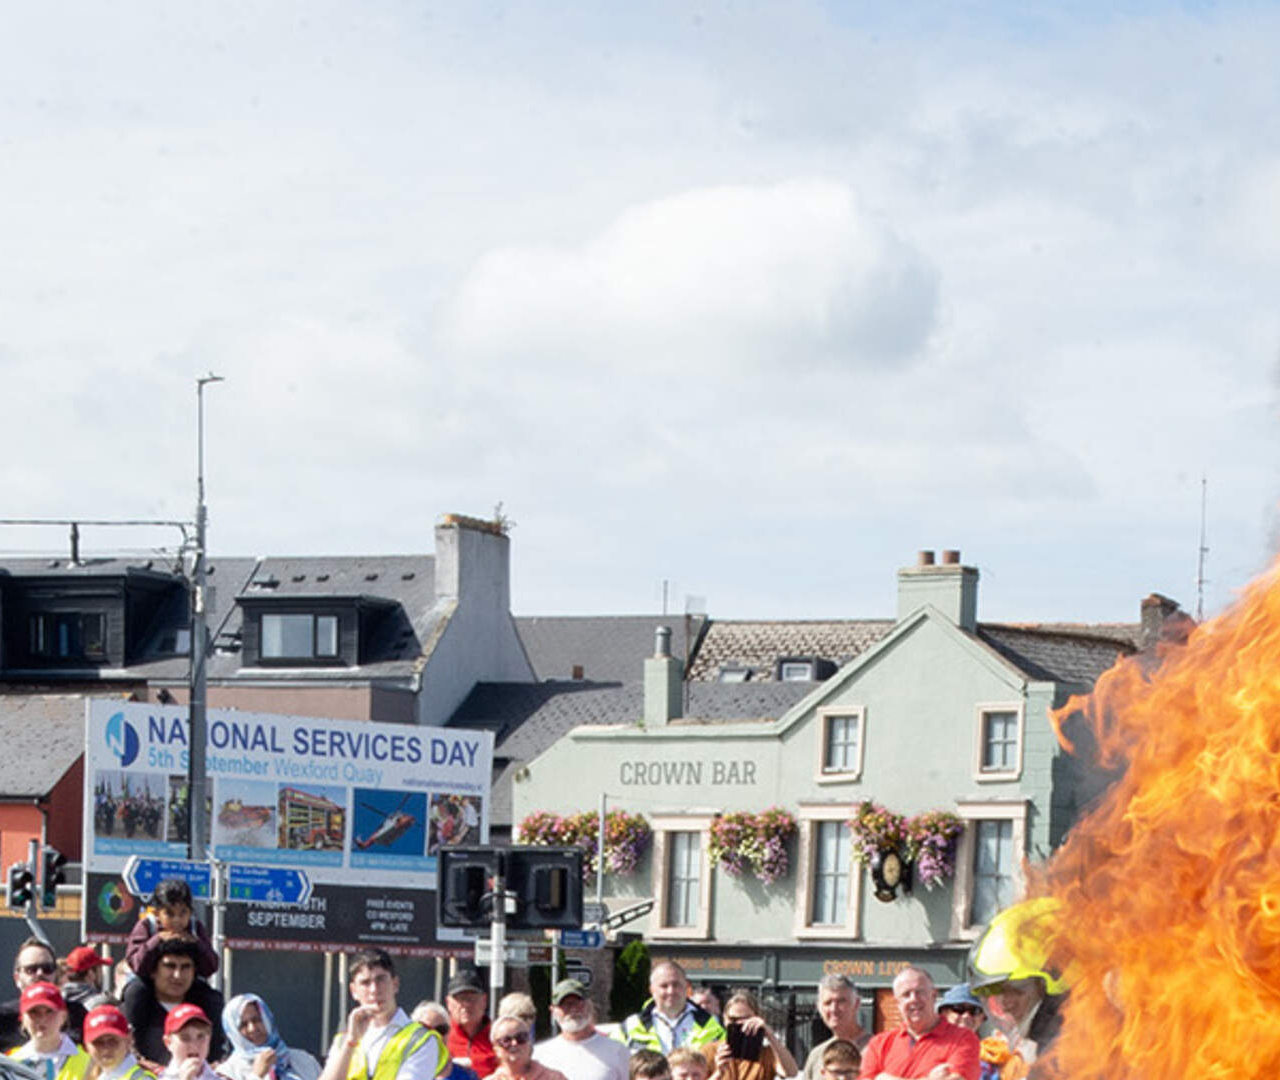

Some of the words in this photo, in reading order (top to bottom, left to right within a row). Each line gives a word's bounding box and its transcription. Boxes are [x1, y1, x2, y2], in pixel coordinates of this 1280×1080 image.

[148, 715, 285, 753] NAONAL
[293, 727, 422, 764] SERVICES
[430, 738, 479, 767] DAY
[148, 746, 175, 768] 5th
[180, 750, 269, 775] Sptember
[274, 758, 338, 781] Wexford
[342, 762, 384, 787] Quay
[620, 761, 703, 786] CROWN
[712, 761, 757, 785] BAR
[247, 911, 326, 929] SEPTEMBER
[823, 960, 875, 977] CROWN
